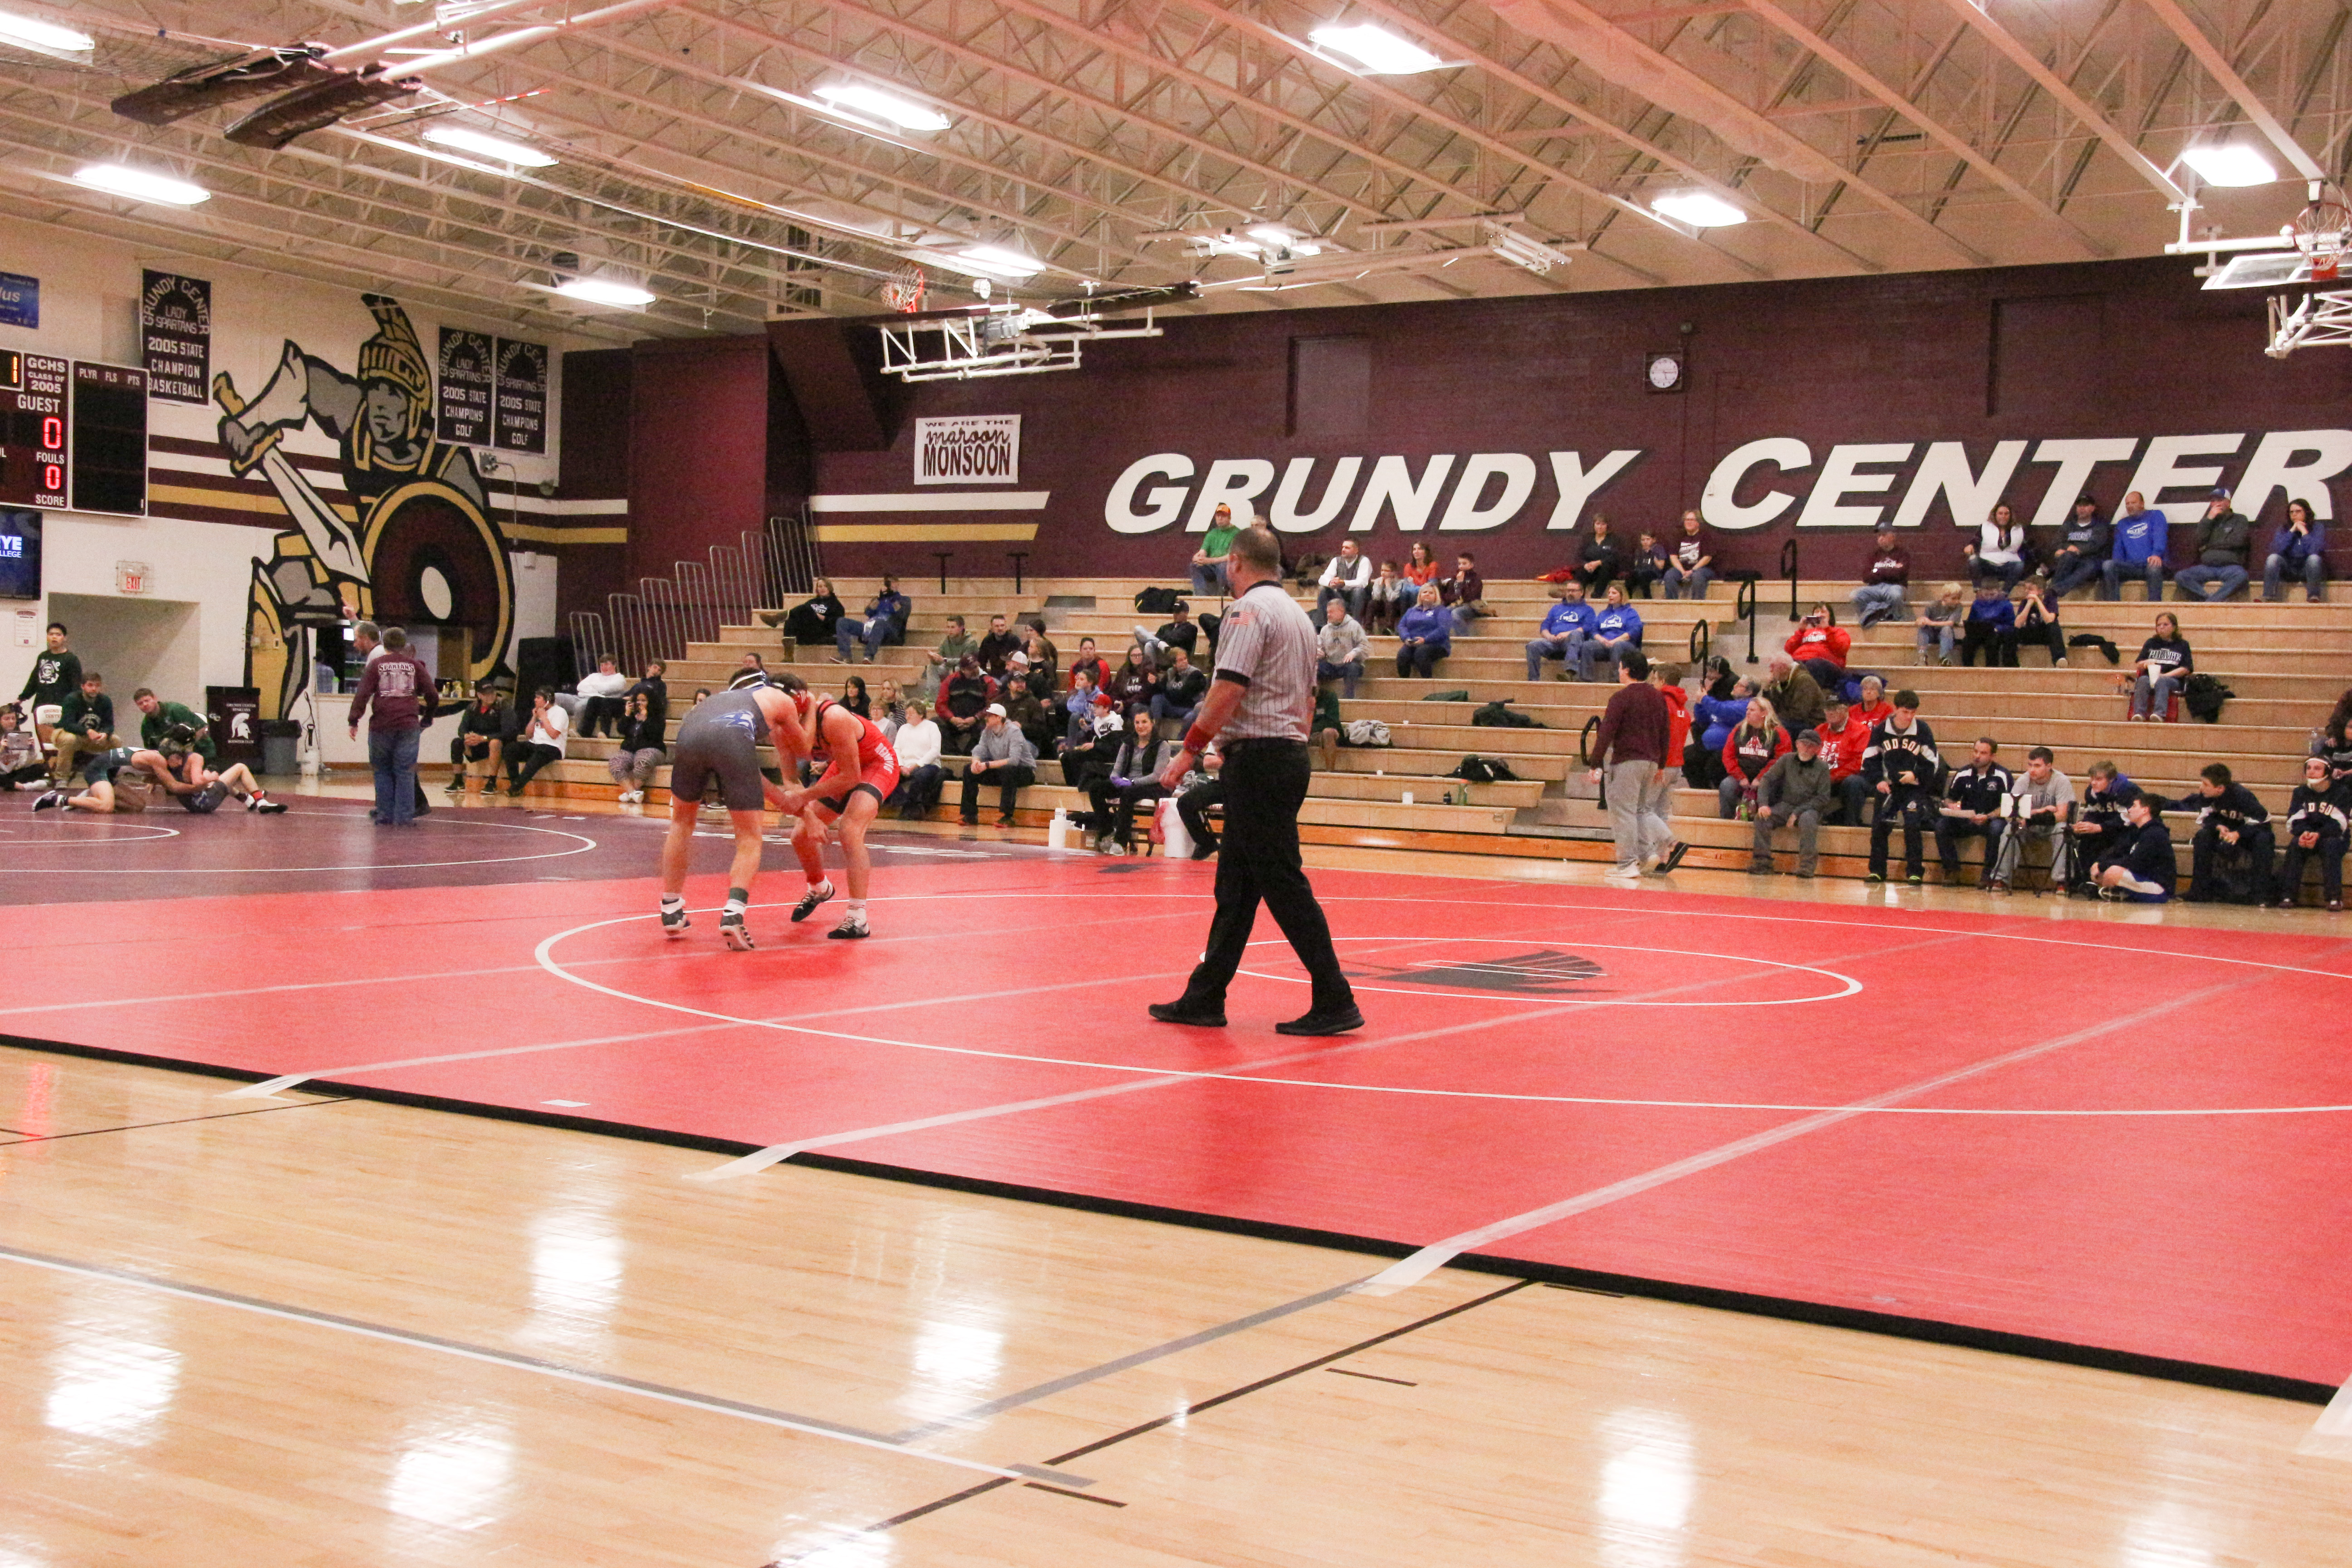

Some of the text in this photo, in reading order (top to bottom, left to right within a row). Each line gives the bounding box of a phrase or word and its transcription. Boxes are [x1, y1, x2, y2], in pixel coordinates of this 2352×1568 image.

[144, 276, 210, 334] GRUNDY CENTER
[165, 305, 188, 320] LADY
[155, 316, 197, 334] SPARTANS
[148, 337, 204, 358] 2005 STATE
[27, 357, 66, 373] GCHS
[439, 332, 492, 382] GRUNDY CENTER
[456, 358, 474, 370] LADY
[28, 372, 65, 383] CLASS OF
[79, 368, 140, 386] PLYR FLS PTS
[152, 359, 200, 378] CHAMPION
[450, 368, 481, 382] SPARTANS
[30, 380, 62, 394] 2005
[148, 377, 203, 398] BASKETBALL
[443, 386, 486, 404] 2005 STATE
[18, 394, 61, 413] GUEST
[500, 395, 541, 413] 2005 STATE
[446, 406, 483, 422] CHAMPIONS
[502, 414, 538, 431] CHAMPIONS
[43, 417, 62, 449] 0
[456, 424, 473, 437] GOLF
[512, 433, 528, 446] GOLF
[926, 427, 1010, 445] maroon
[36, 451, 64, 464] FOULS
[923, 442, 1011, 477] MONSOON
[45, 465, 61, 490] 0
[1105, 429, 2352, 534] GRUNDY CENTER
[35, 495, 64, 506] SCORE
[126, 576, 141, 589] EXIT
[378, 662, 415, 672] SPARTANS
